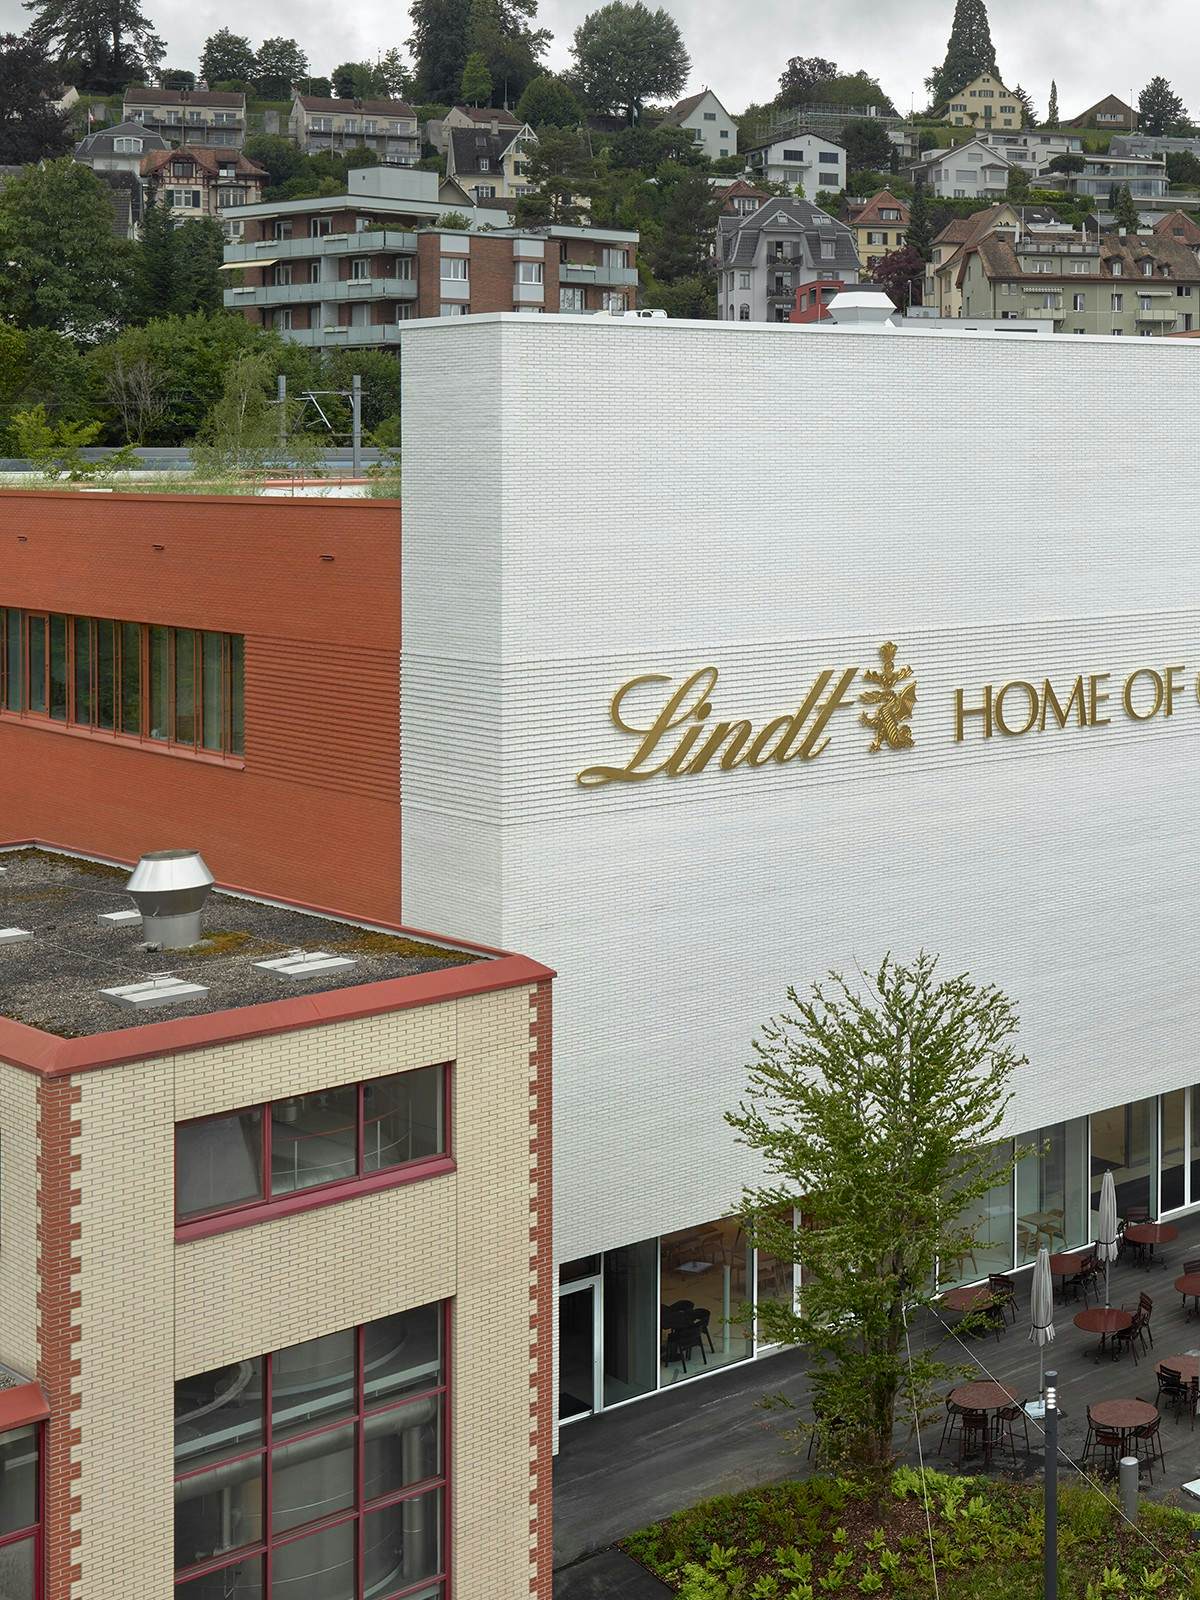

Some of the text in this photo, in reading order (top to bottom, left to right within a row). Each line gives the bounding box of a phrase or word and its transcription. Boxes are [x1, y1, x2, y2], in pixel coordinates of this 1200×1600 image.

[576, 666, 859, 788] Lindt
[954, 673, 1111, 742] HOME
[1122, 665, 1185, 721] OF
